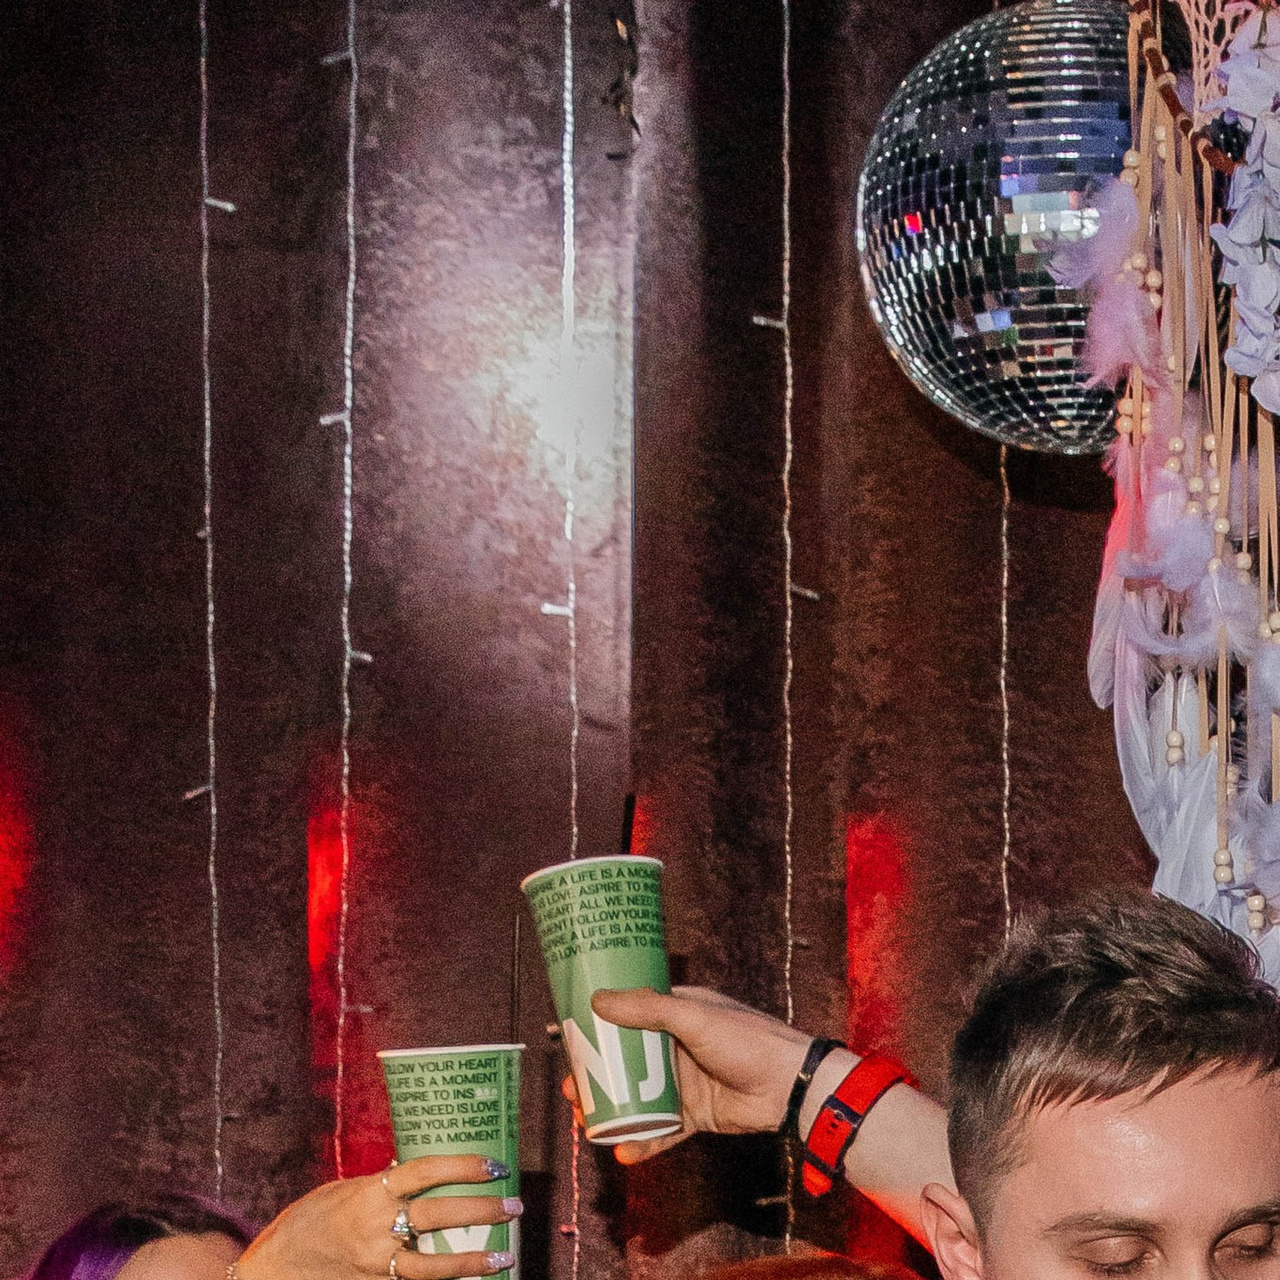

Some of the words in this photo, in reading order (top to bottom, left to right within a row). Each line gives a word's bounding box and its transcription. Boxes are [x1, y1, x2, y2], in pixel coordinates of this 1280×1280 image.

[558, 875, 568, 888] A
[571, 869, 598, 884] LIFE
[601, 867, 613, 880] IS
[616, 867, 626, 878] A
[579, 880, 622, 897] ASPIRE
[626, 880, 641, 893] TO
[579, 899, 603, 911] ALL
[604, 896, 624, 907] WE
[570, 930, 580, 942] A
[581, 924, 608, 940] LIFE
[609, 922, 622, 935] IS
[624, 921, 634, 933] A
[588, 937, 631, 952] ASPIRE
[633, 935, 648, 947] TO
[418, 1060, 455, 1073] YOUR
[458, 1056, 499, 1071] HEART
[414, 1076, 426, 1088] IS
[429, 1076, 439, 1086] A
[441, 1071, 499, 1085] MOMENT
[434, 1089, 450, 1101] TO
[421, 1103, 455, 1116] NEED
[457, 1102, 469, 1114] IS
[471, 1100, 500, 1114] LOVE
[424, 1117, 460, 1131] YOUR
[461, 1114, 500, 1128] HEART
[421, 1133, 431, 1145] IS
[434, 1133, 444, 1143] A
[446, 1128, 501, 1143] MOMENT
